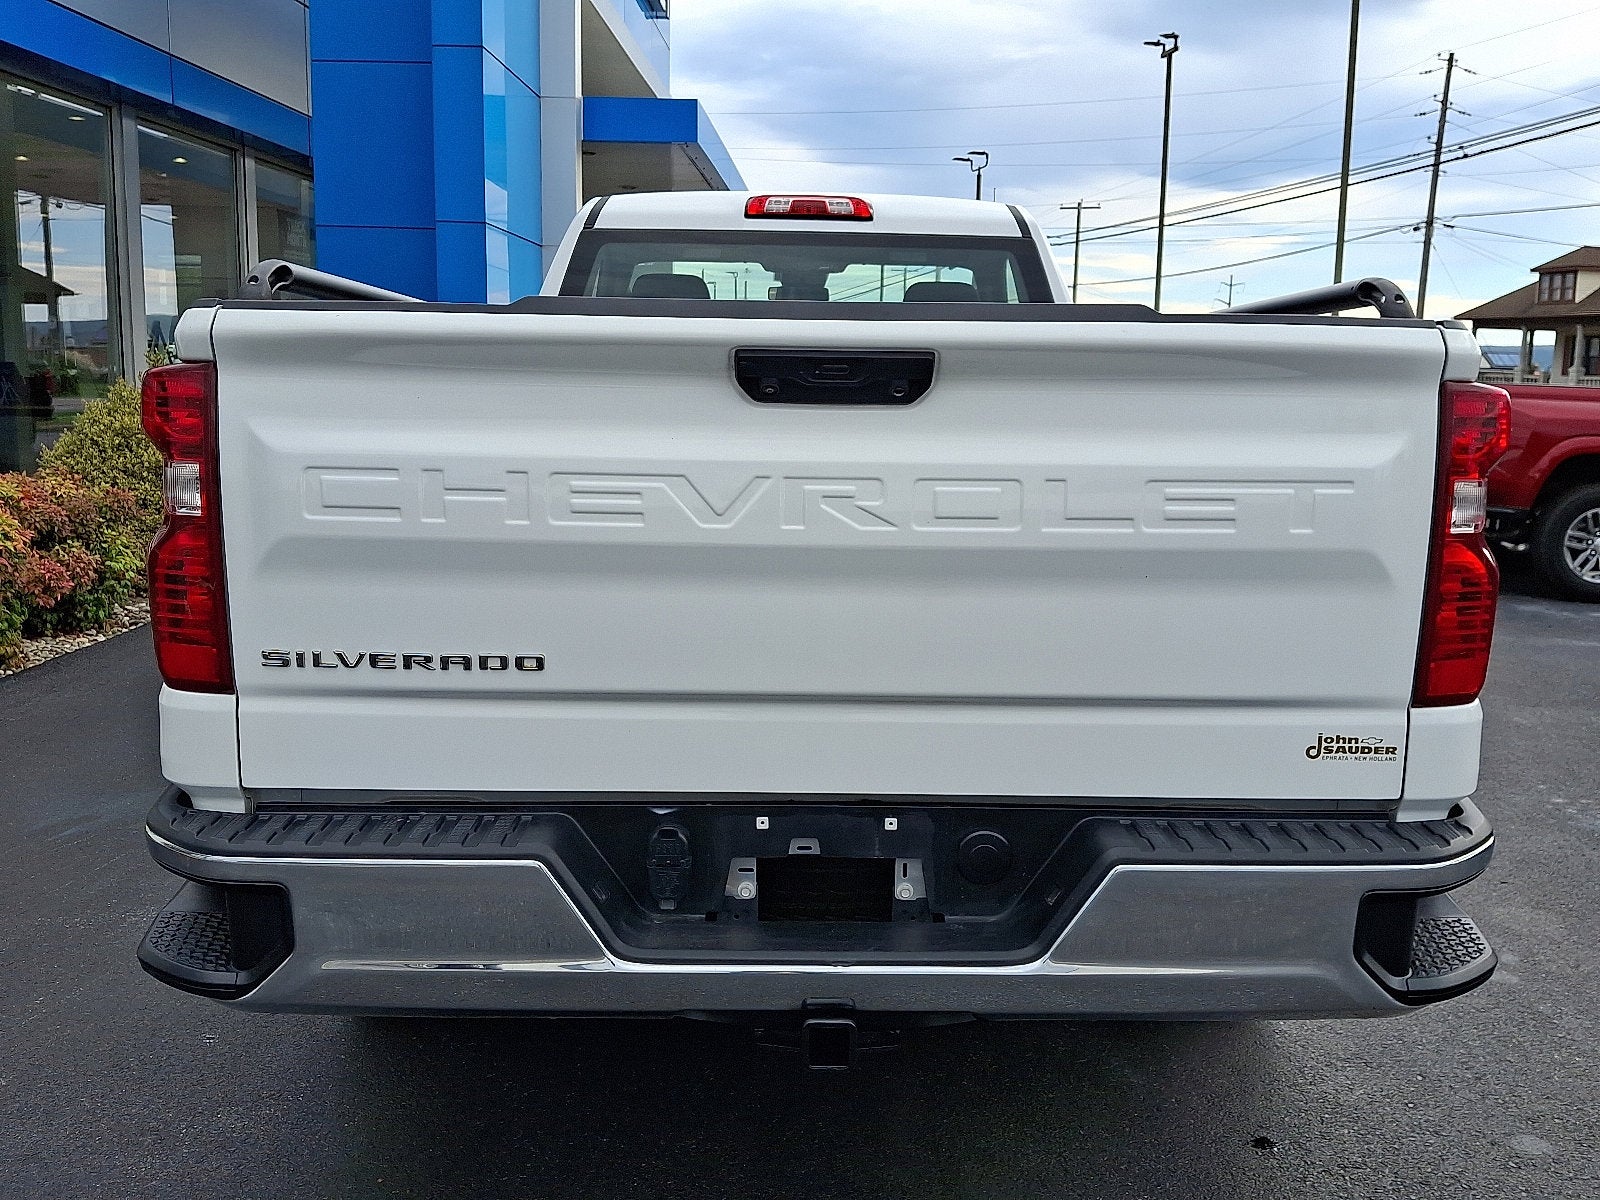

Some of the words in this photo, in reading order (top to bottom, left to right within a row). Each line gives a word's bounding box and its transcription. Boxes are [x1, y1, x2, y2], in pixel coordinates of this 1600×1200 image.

[303, 466, 1355, 534] CHEVROLET
[261, 649, 546, 672] SILVERADO
[1322, 745, 1398, 755] SAUDER
